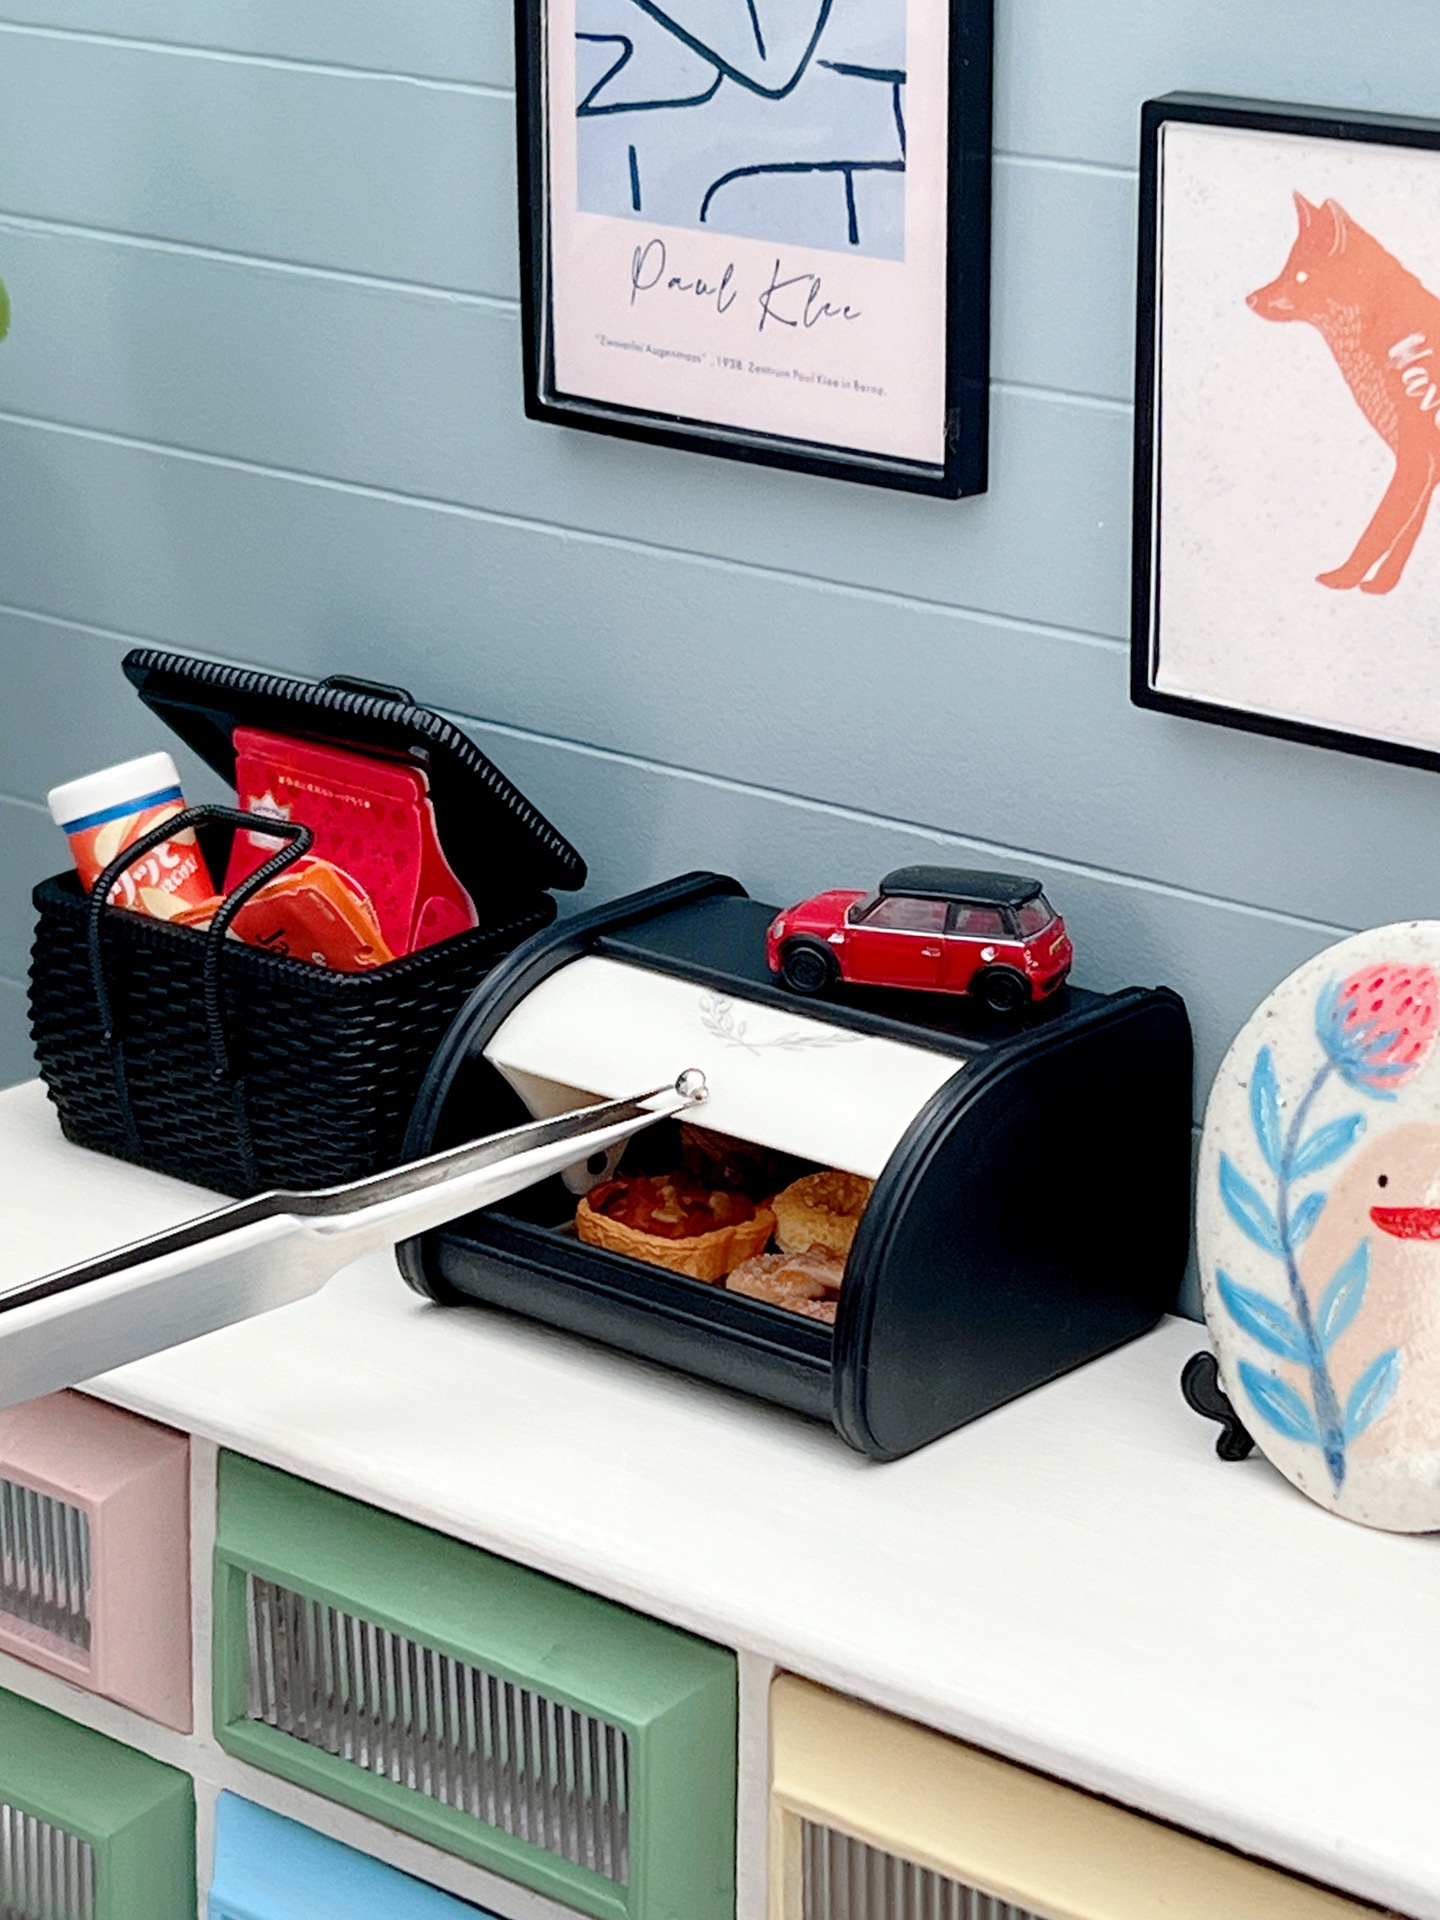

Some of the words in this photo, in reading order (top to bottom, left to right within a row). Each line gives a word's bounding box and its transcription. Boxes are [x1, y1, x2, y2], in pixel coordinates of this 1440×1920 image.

[630, 238, 738, 313] Paul
[758, 257, 862, 332] Klee
[792, 369, 816, 384] Paul
[816, 375, 839, 388] Klee
